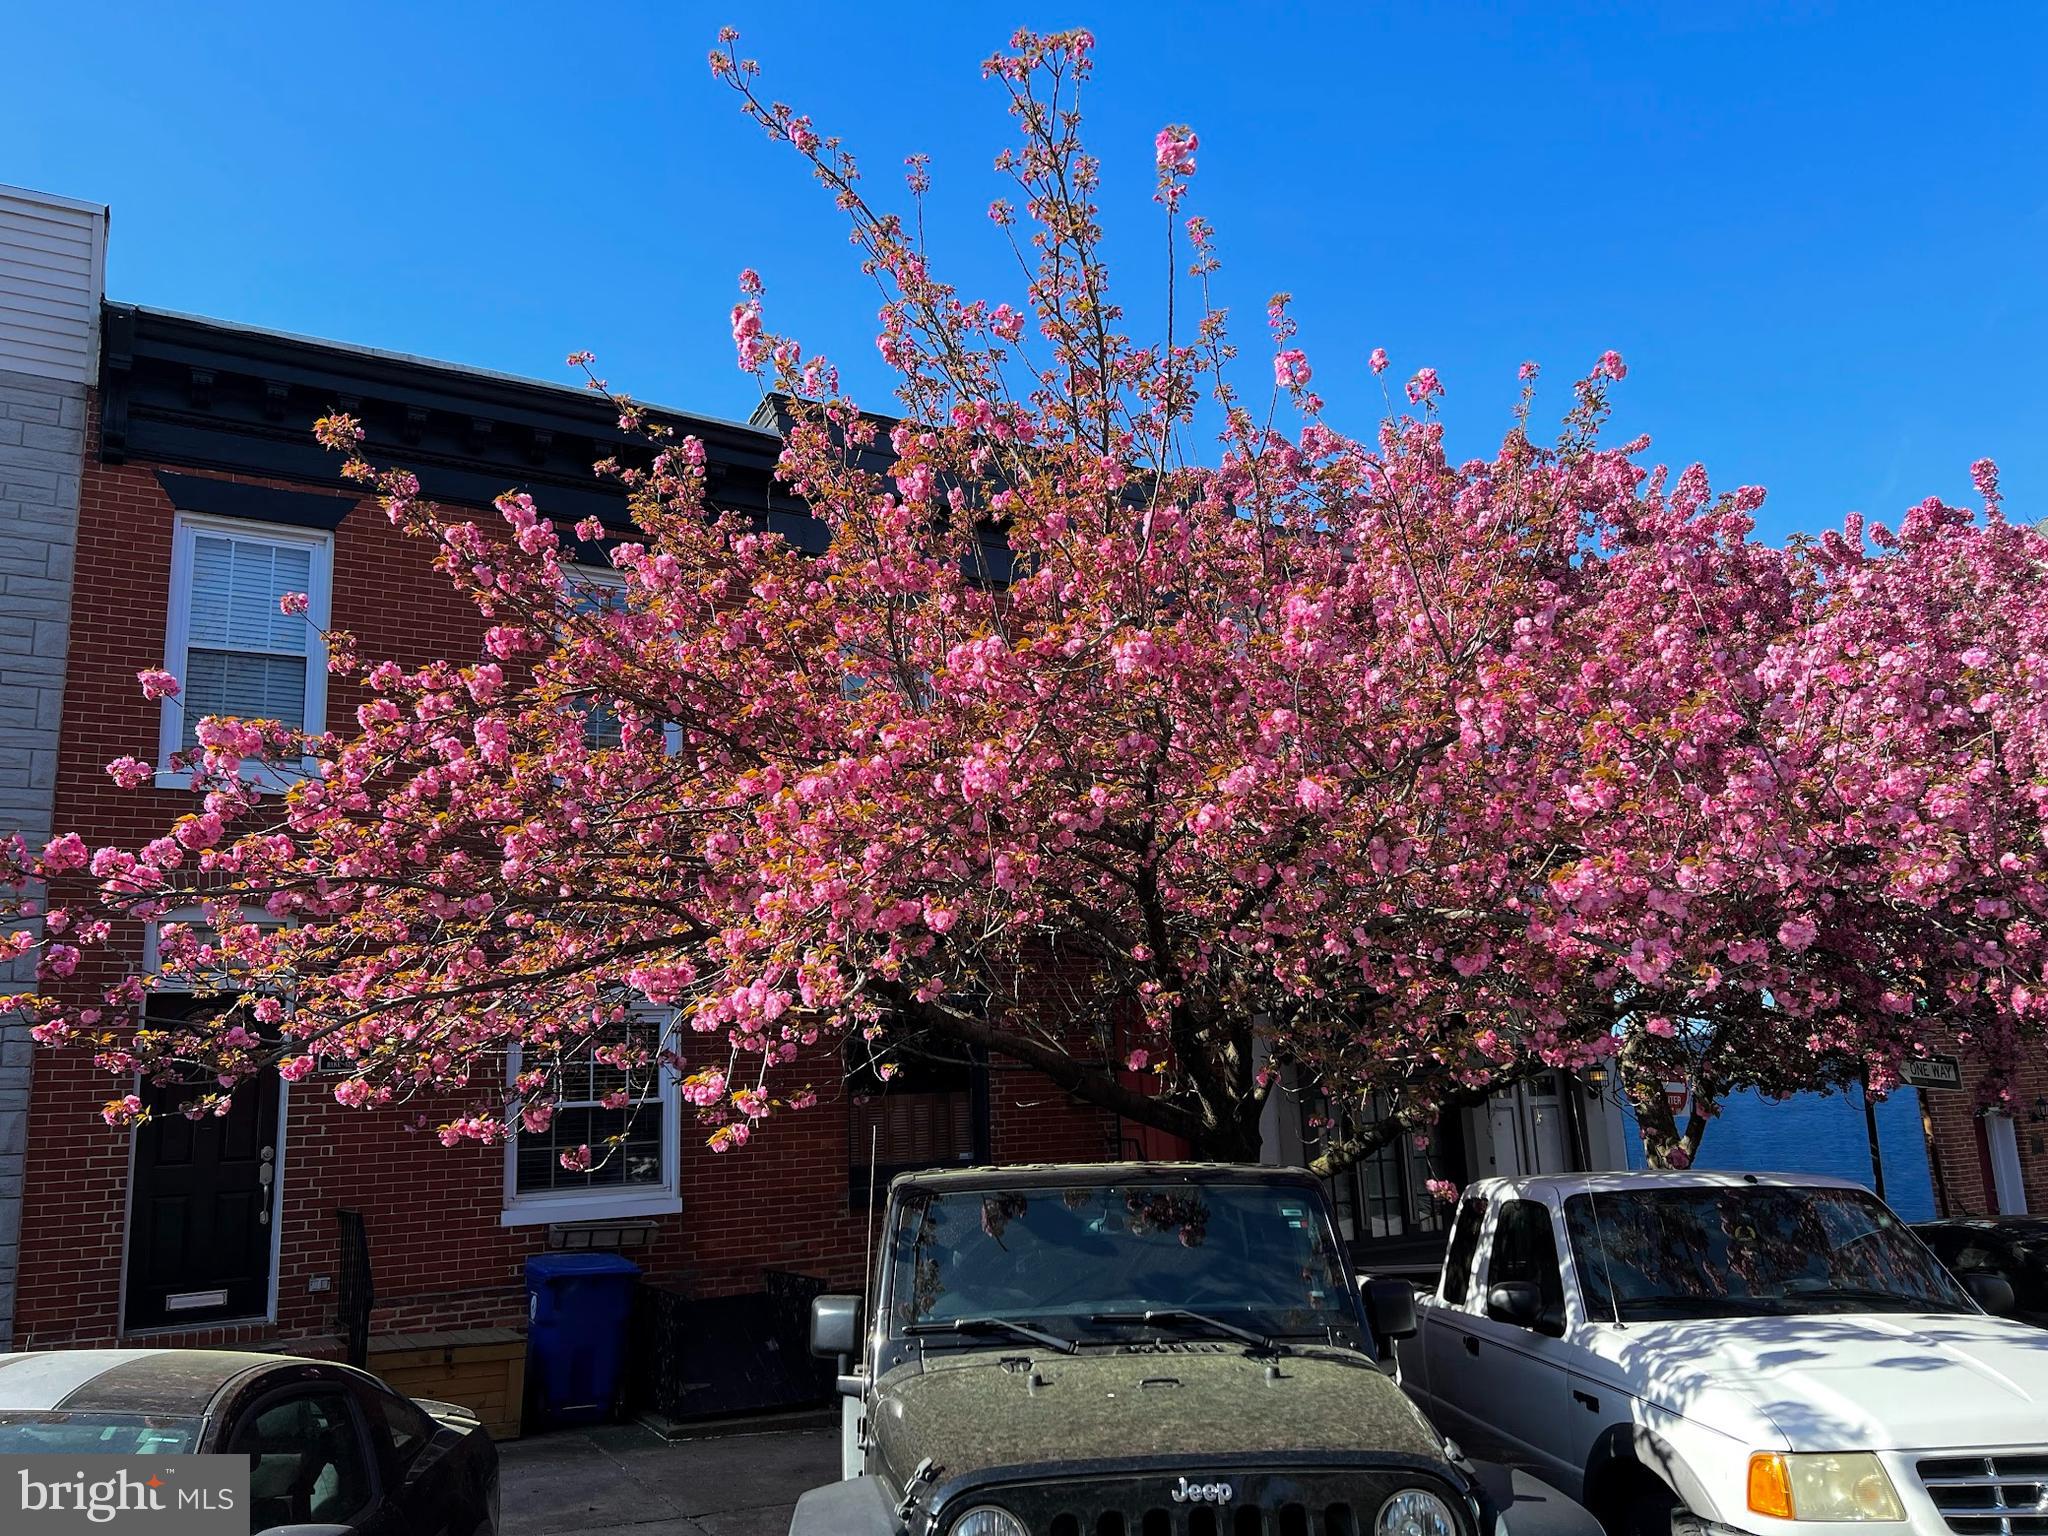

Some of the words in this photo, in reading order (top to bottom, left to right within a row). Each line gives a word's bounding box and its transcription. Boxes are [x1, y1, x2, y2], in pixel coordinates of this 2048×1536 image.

[1910, 1062, 1930, 1077] ONE
[1932, 1064, 1952, 1079] WAY
[1171, 1477, 1232, 1505] Jeep
